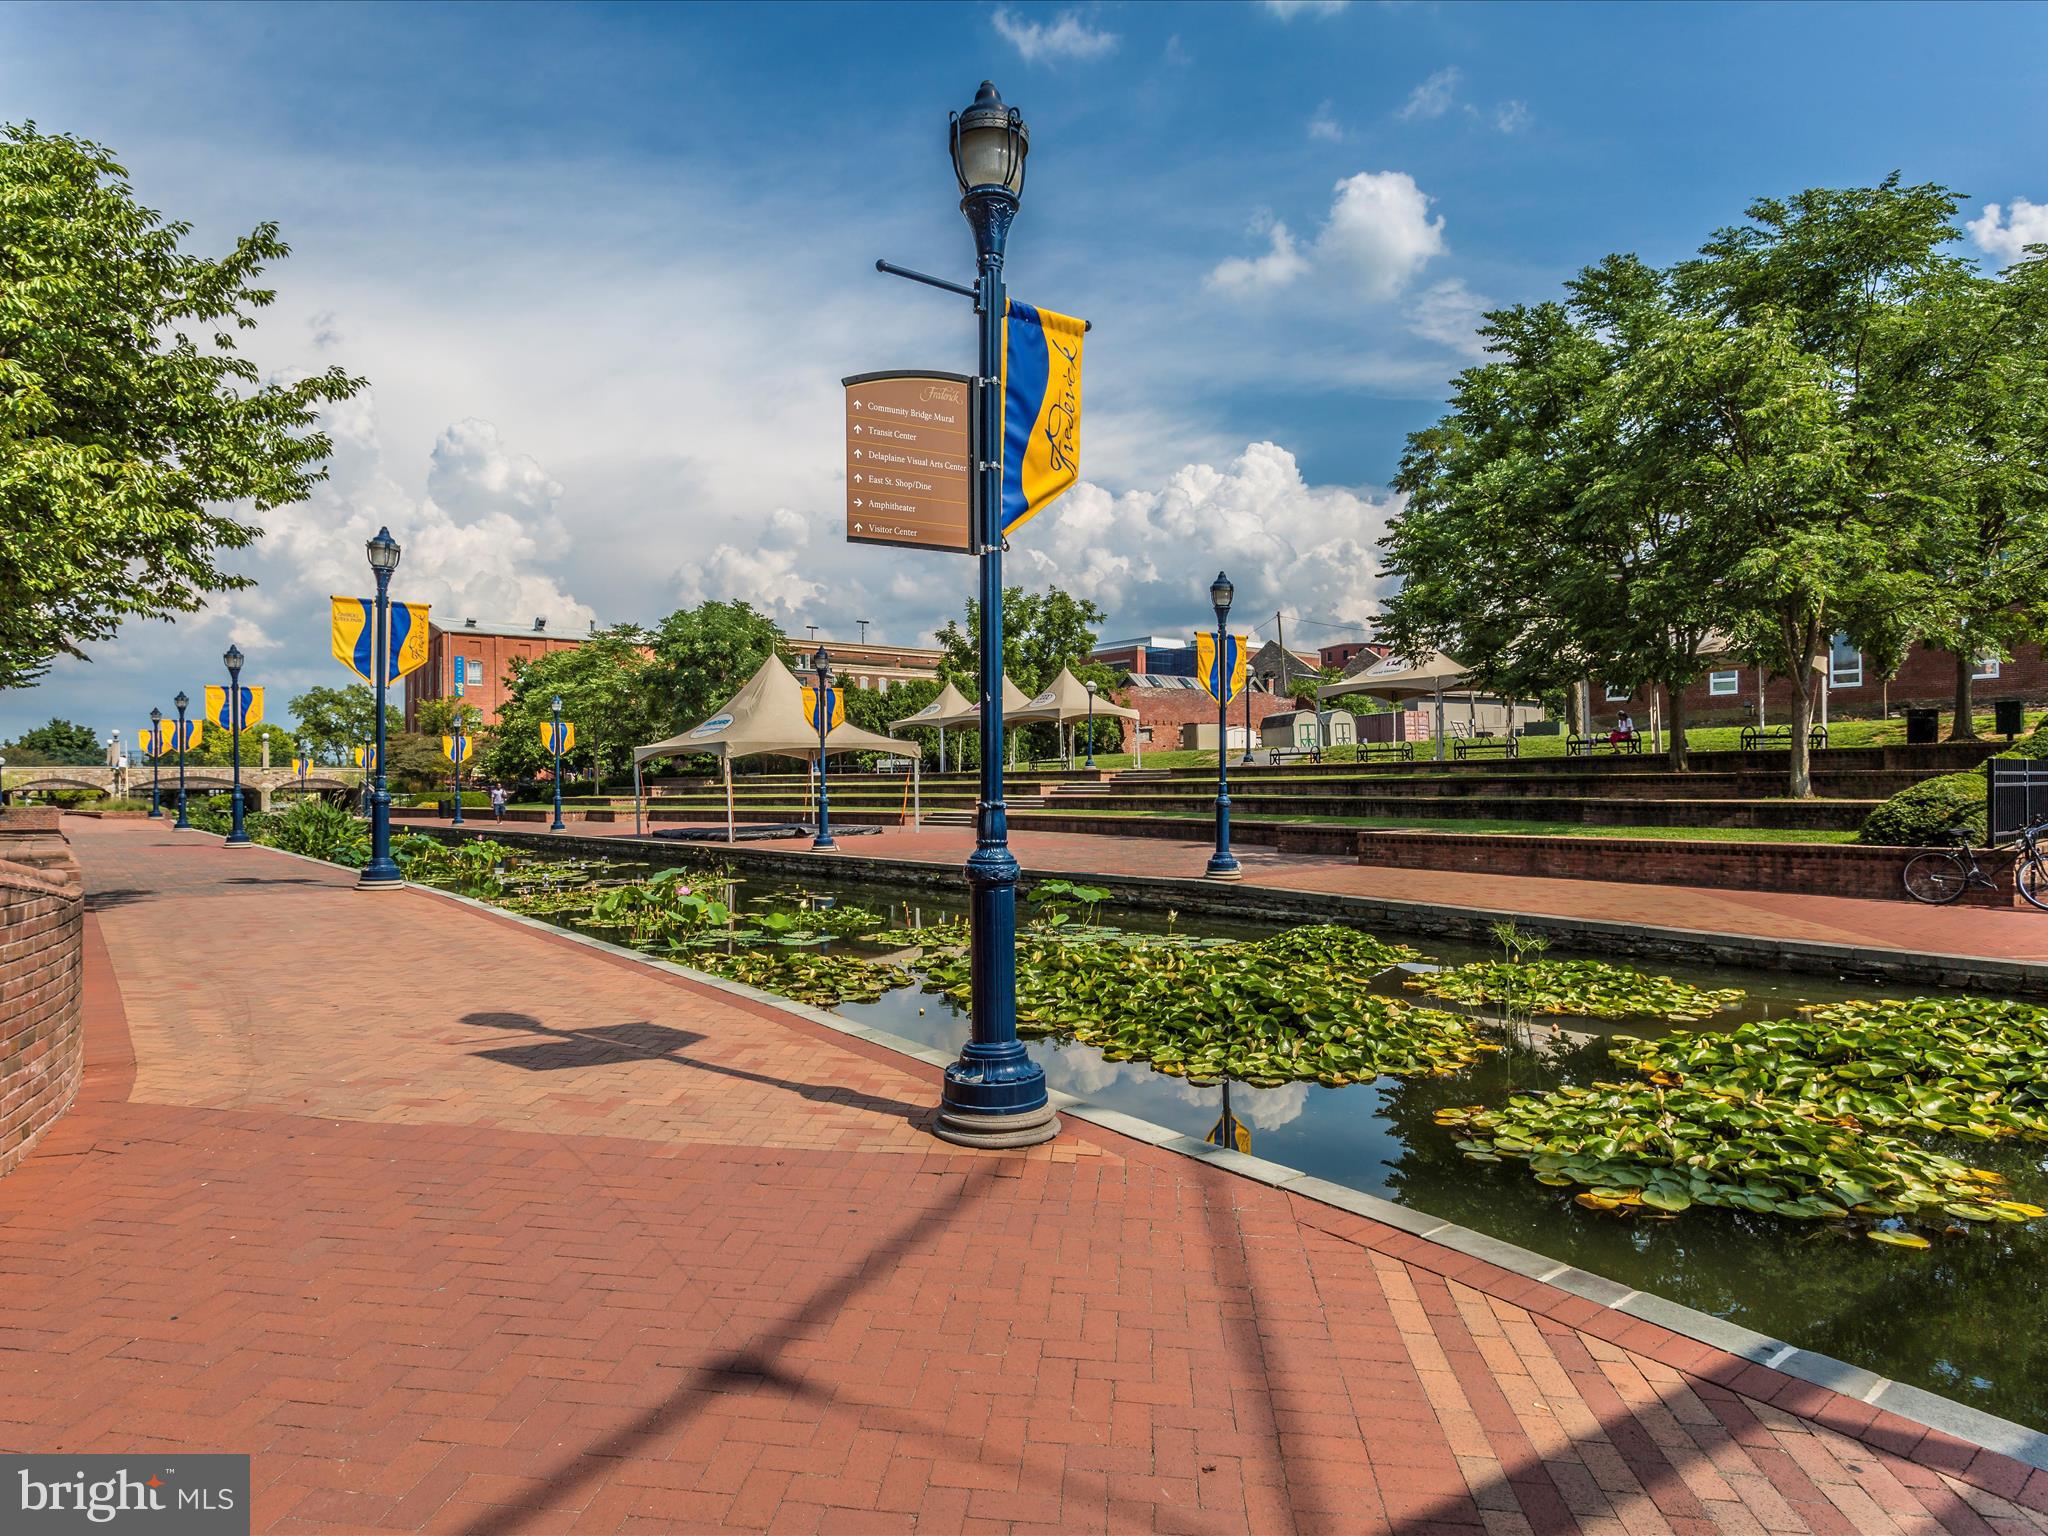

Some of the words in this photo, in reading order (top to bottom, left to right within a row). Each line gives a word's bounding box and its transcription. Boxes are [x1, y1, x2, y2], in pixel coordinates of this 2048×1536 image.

[919, 386, 964, 405] Frederick
[868, 402, 909, 417] Community
[910, 409, 933, 421] Bridge
[934, 413, 955, 424] Mural
[1045, 338, 1078, 477] Frederick
[868, 426, 893, 438] Transit
[894, 430, 917, 441] Center
[868, 451, 906, 464] Delaplaine
[907, 456, 928, 467] Visual
[929, 459, 944, 469] Arts
[945, 461, 967, 472] Center
[868, 475, 883, 485] East
[884, 477, 894, 486] St.
[895, 478, 932, 491] Shop/Dine
[868, 499, 916, 513] Amphitheater
[868, 524, 893, 534] Visitor
[894, 526, 917, 537] Center
